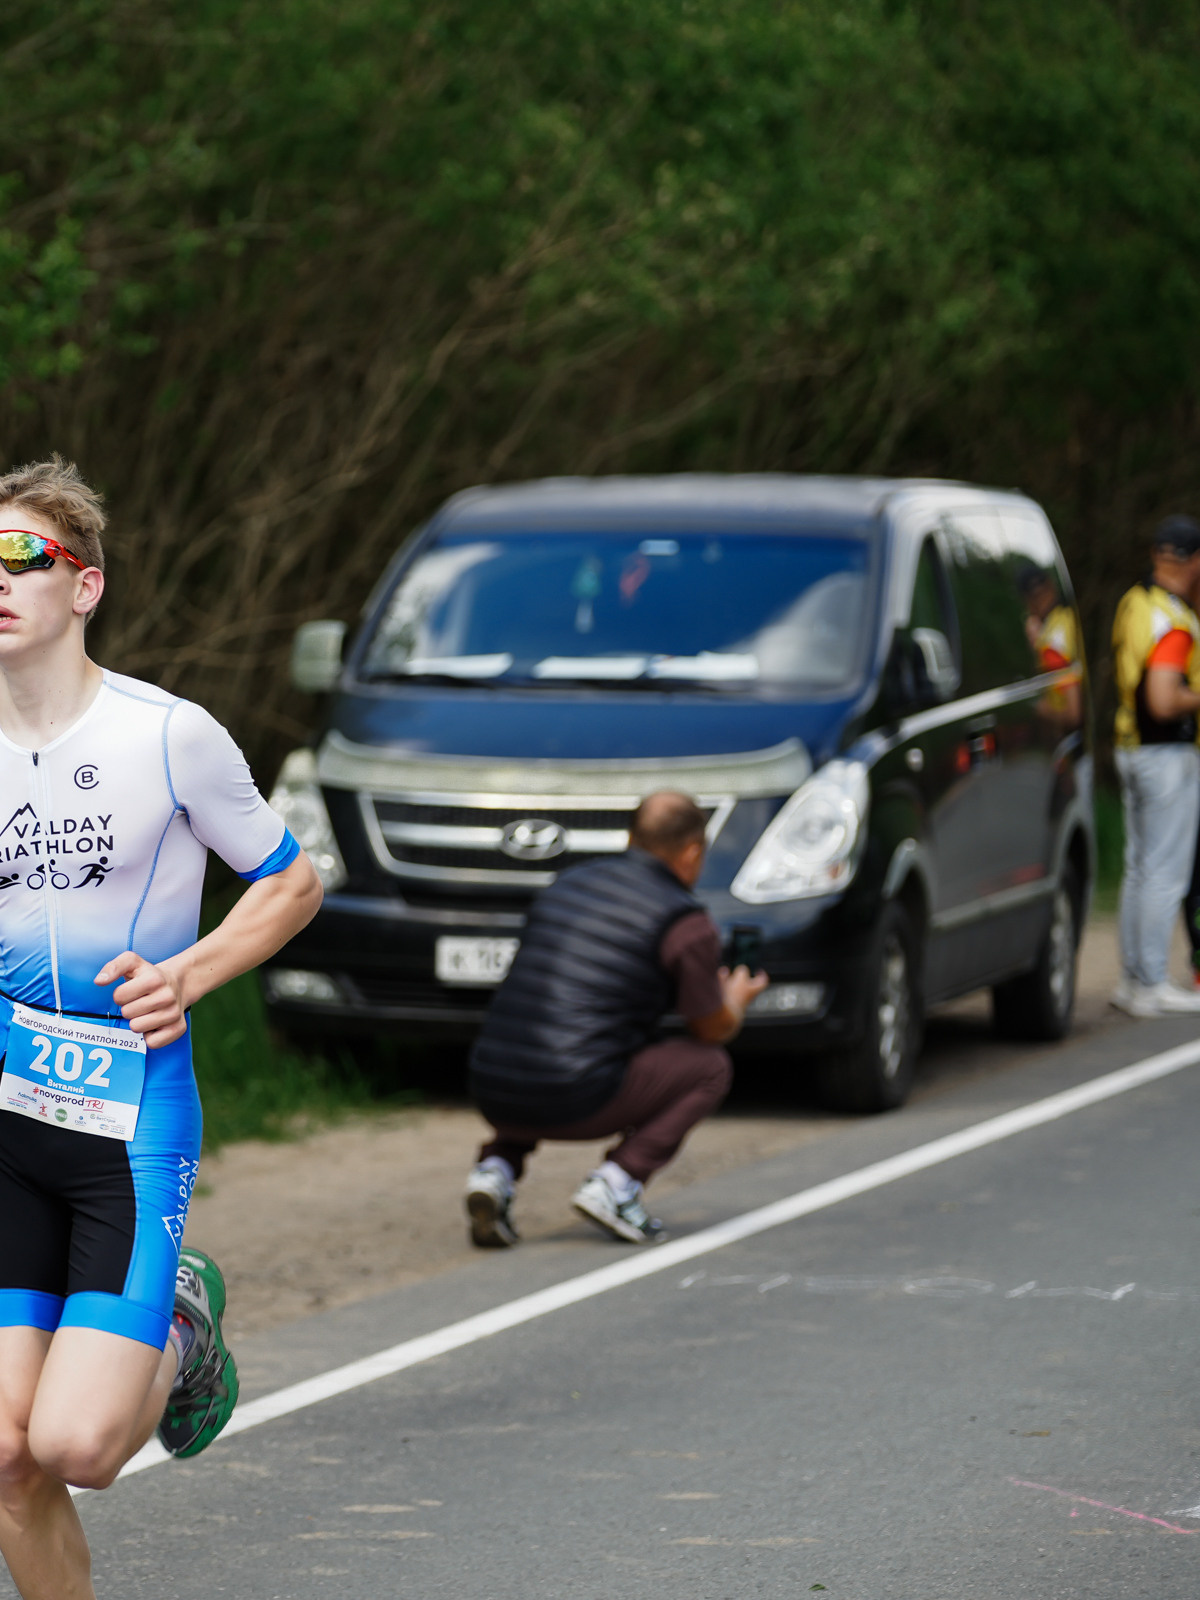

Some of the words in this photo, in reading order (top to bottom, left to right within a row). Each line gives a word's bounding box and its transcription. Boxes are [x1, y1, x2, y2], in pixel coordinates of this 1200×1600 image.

[14, 814, 113, 839] VALDAY
[18, 1016, 74, 1037] НОВГОРОДСКИЙ
[75, 1031, 118, 1046] ТРИАТЛОН
[119, 1039, 138, 1049] 2023
[29, 1034, 113, 1088] 202
[47, 1078, 85, 1095] Виталий
